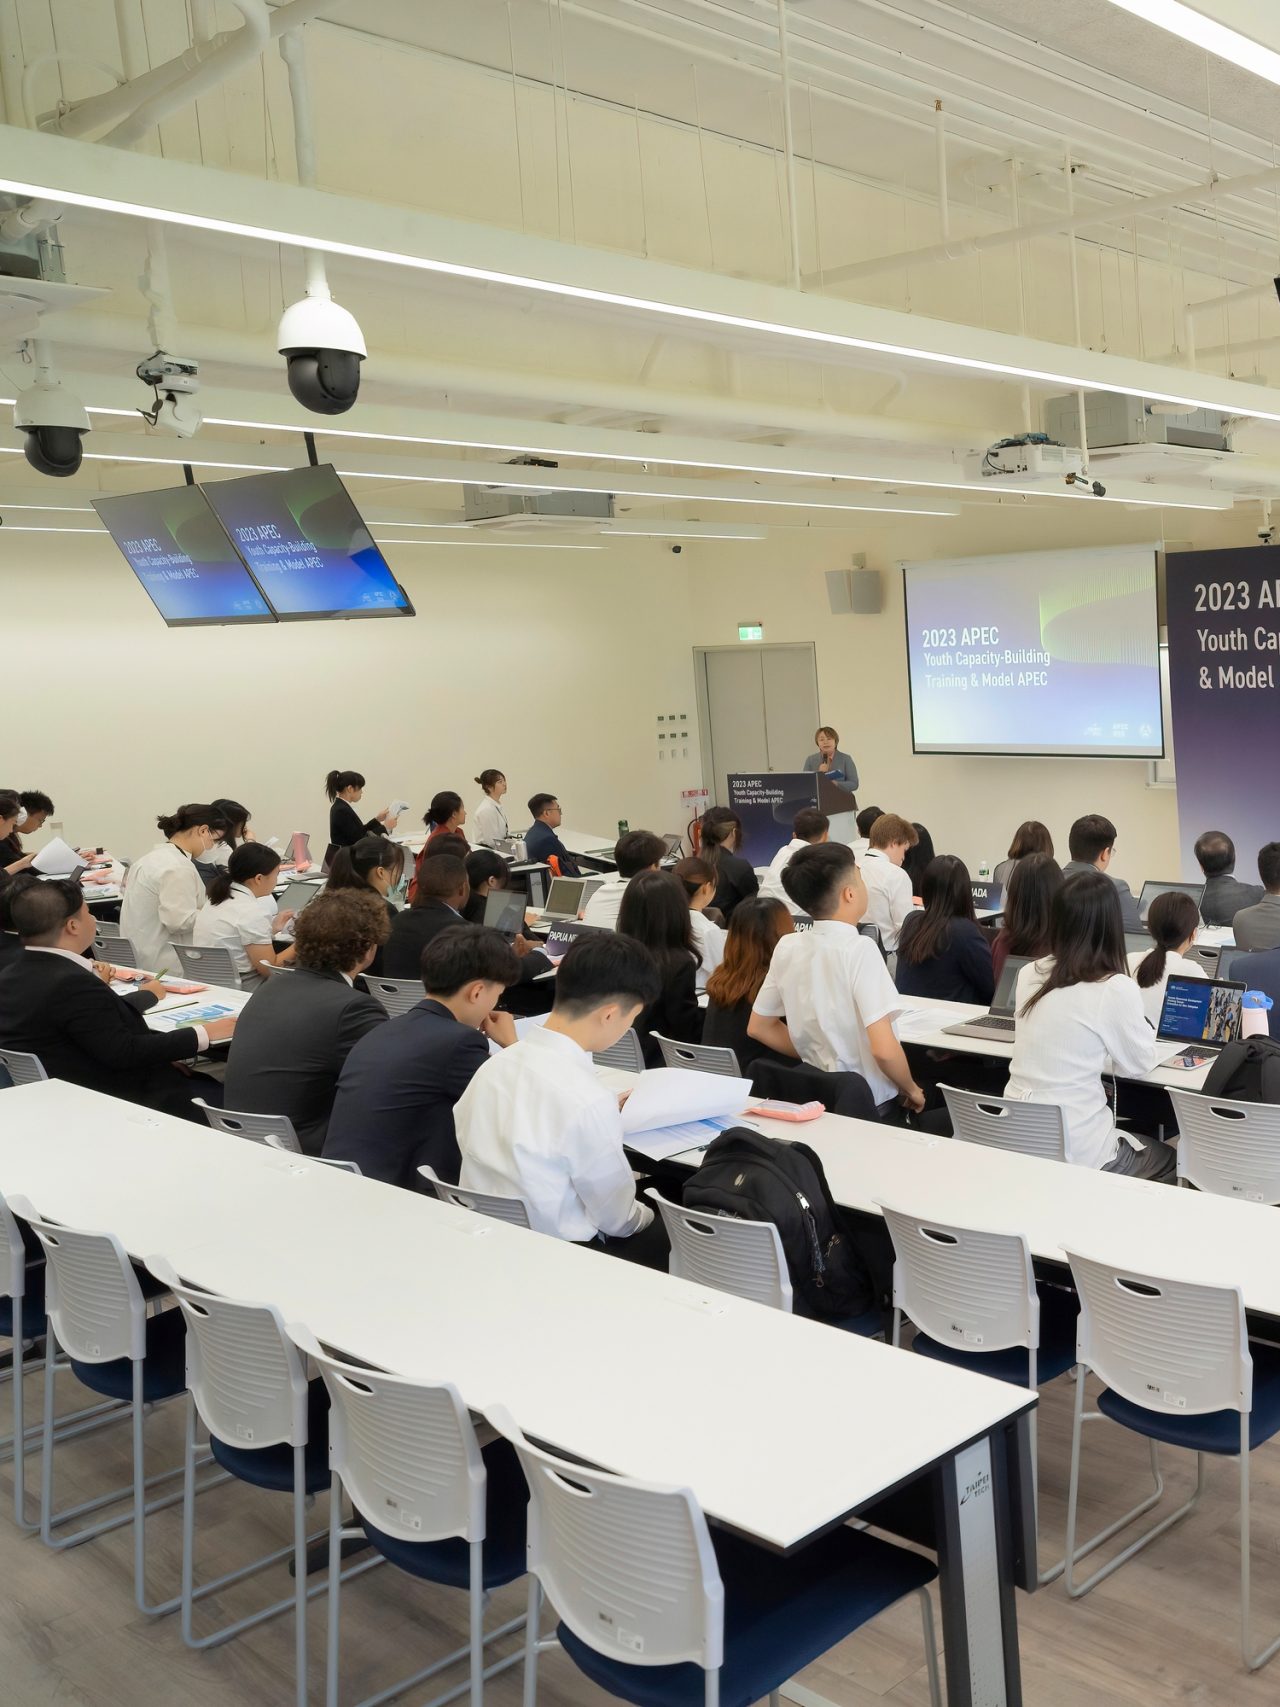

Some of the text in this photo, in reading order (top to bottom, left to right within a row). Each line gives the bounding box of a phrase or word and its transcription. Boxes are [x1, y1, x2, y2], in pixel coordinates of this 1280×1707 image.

[236, 524, 281, 542] 2023 APEC
[141, 538, 162, 552] APEC
[304, 557, 324, 568] APEC
[1195, 580, 1250, 612] 2023
[922, 626, 1000, 648] 2023 APEC
[1196, 628, 1248, 652] Youth
[924, 649, 1050, 668] Youth Capacity-Building
[925, 672, 1048, 690] Training & Model APEC
[1199, 666, 1212, 689] &
[1218, 664, 1274, 688] Model
[732, 780, 762, 788] 2023 APEC
[548, 930, 568, 942] PAPUA
